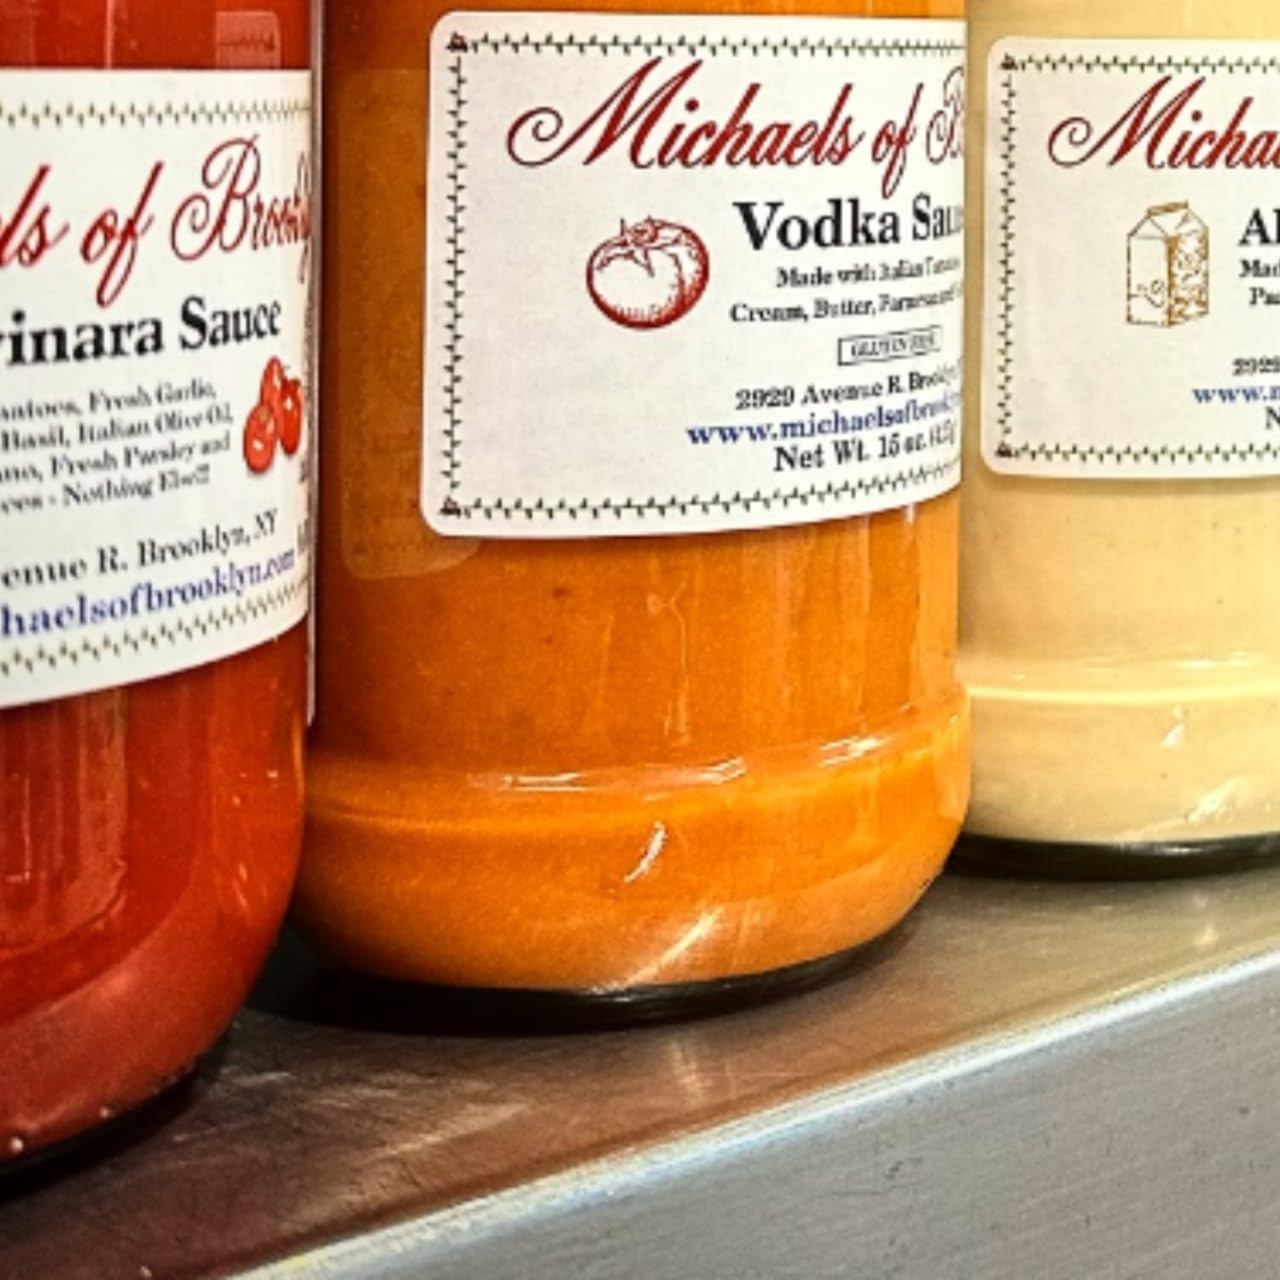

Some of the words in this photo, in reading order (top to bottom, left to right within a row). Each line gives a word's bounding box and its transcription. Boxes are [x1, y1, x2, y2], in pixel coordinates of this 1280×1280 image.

[507, 55, 865, 169] Michaels
[872, 82, 924, 199] of
[80, 160, 165, 308] of
[733, 197, 900, 250] Vodka
[776, 267, 832, 288] Made
[837, 263, 876, 283] with
[0, 309, 164, 366] inara
[179, 295, 281, 350] Sauce
[729, 303, 809, 322] Cream,
[812, 298, 876, 320] Butter,
[800, 381, 883, 405] Avenue
[773, 444, 825, 472] Net
[831, 437, 870, 466] Wt.
[878, 432, 900, 459] 15
[63, 477, 153, 506] Nothing
[1, 560, 88, 589] enue
[96, 547, 128, 574] R.
[137, 523, 250, 567] Brooklyn,
